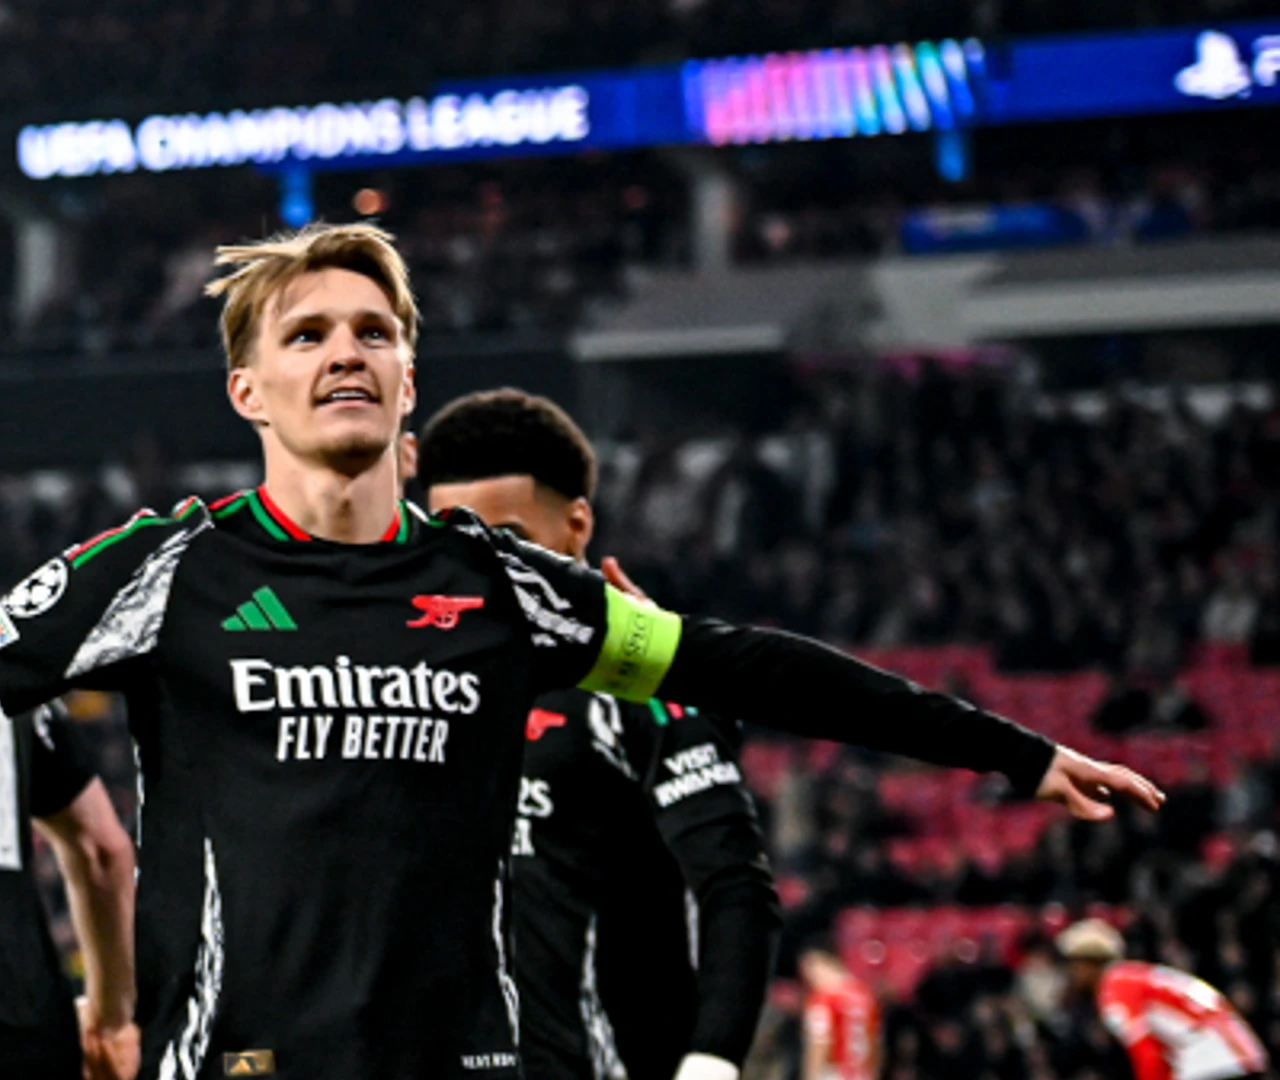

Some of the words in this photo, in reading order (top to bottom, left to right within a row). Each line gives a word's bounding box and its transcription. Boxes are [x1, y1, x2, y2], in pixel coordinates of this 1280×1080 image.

[229, 656, 480, 714] Emirates
[276, 717, 333, 762] FLY
[341, 715, 449, 762] BETTER
